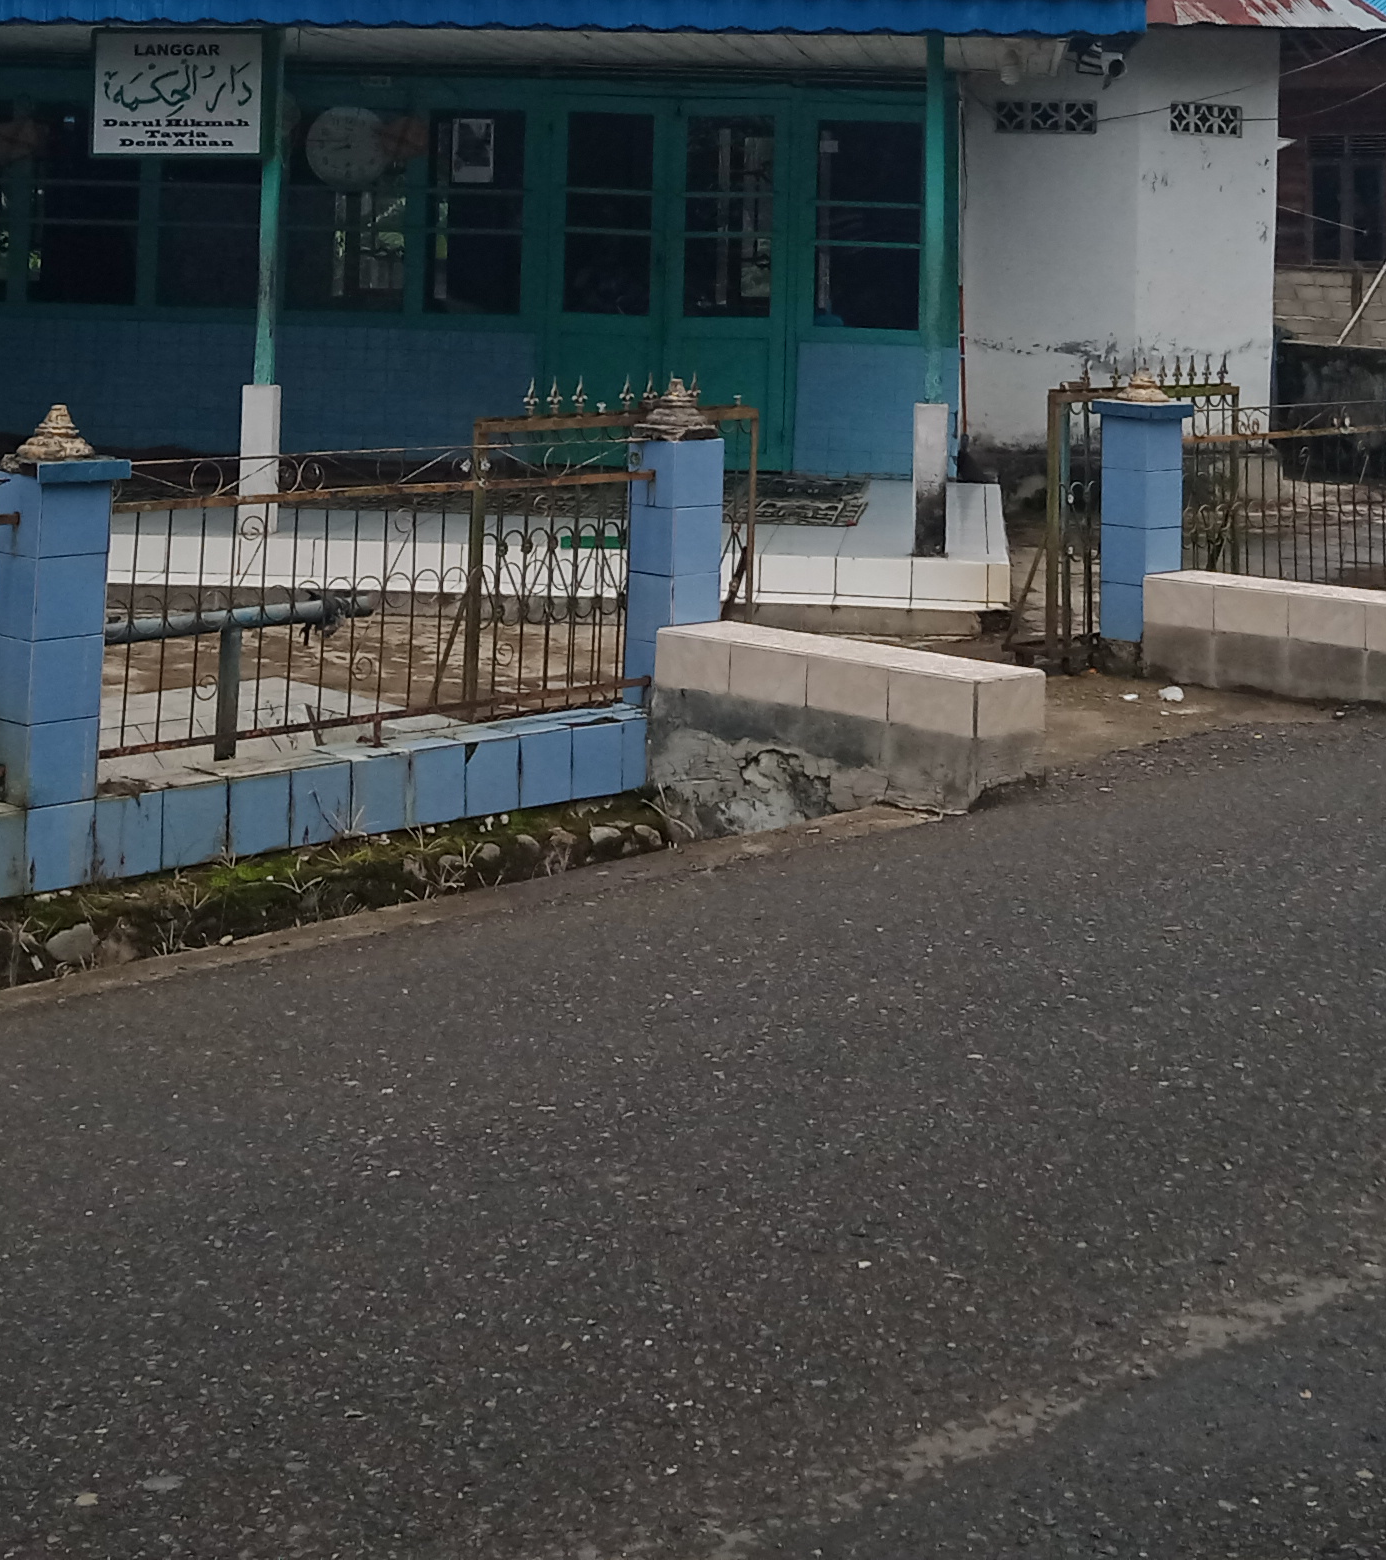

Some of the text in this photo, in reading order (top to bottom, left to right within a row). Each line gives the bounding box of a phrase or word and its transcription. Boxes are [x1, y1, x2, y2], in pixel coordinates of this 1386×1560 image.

[133, 43, 221, 57] LANGGAR
[102, 118, 250, 128] Darul Hikmah
[144, 129, 209, 139] Tawia
[118, 138, 235, 148] Desa Aluan
